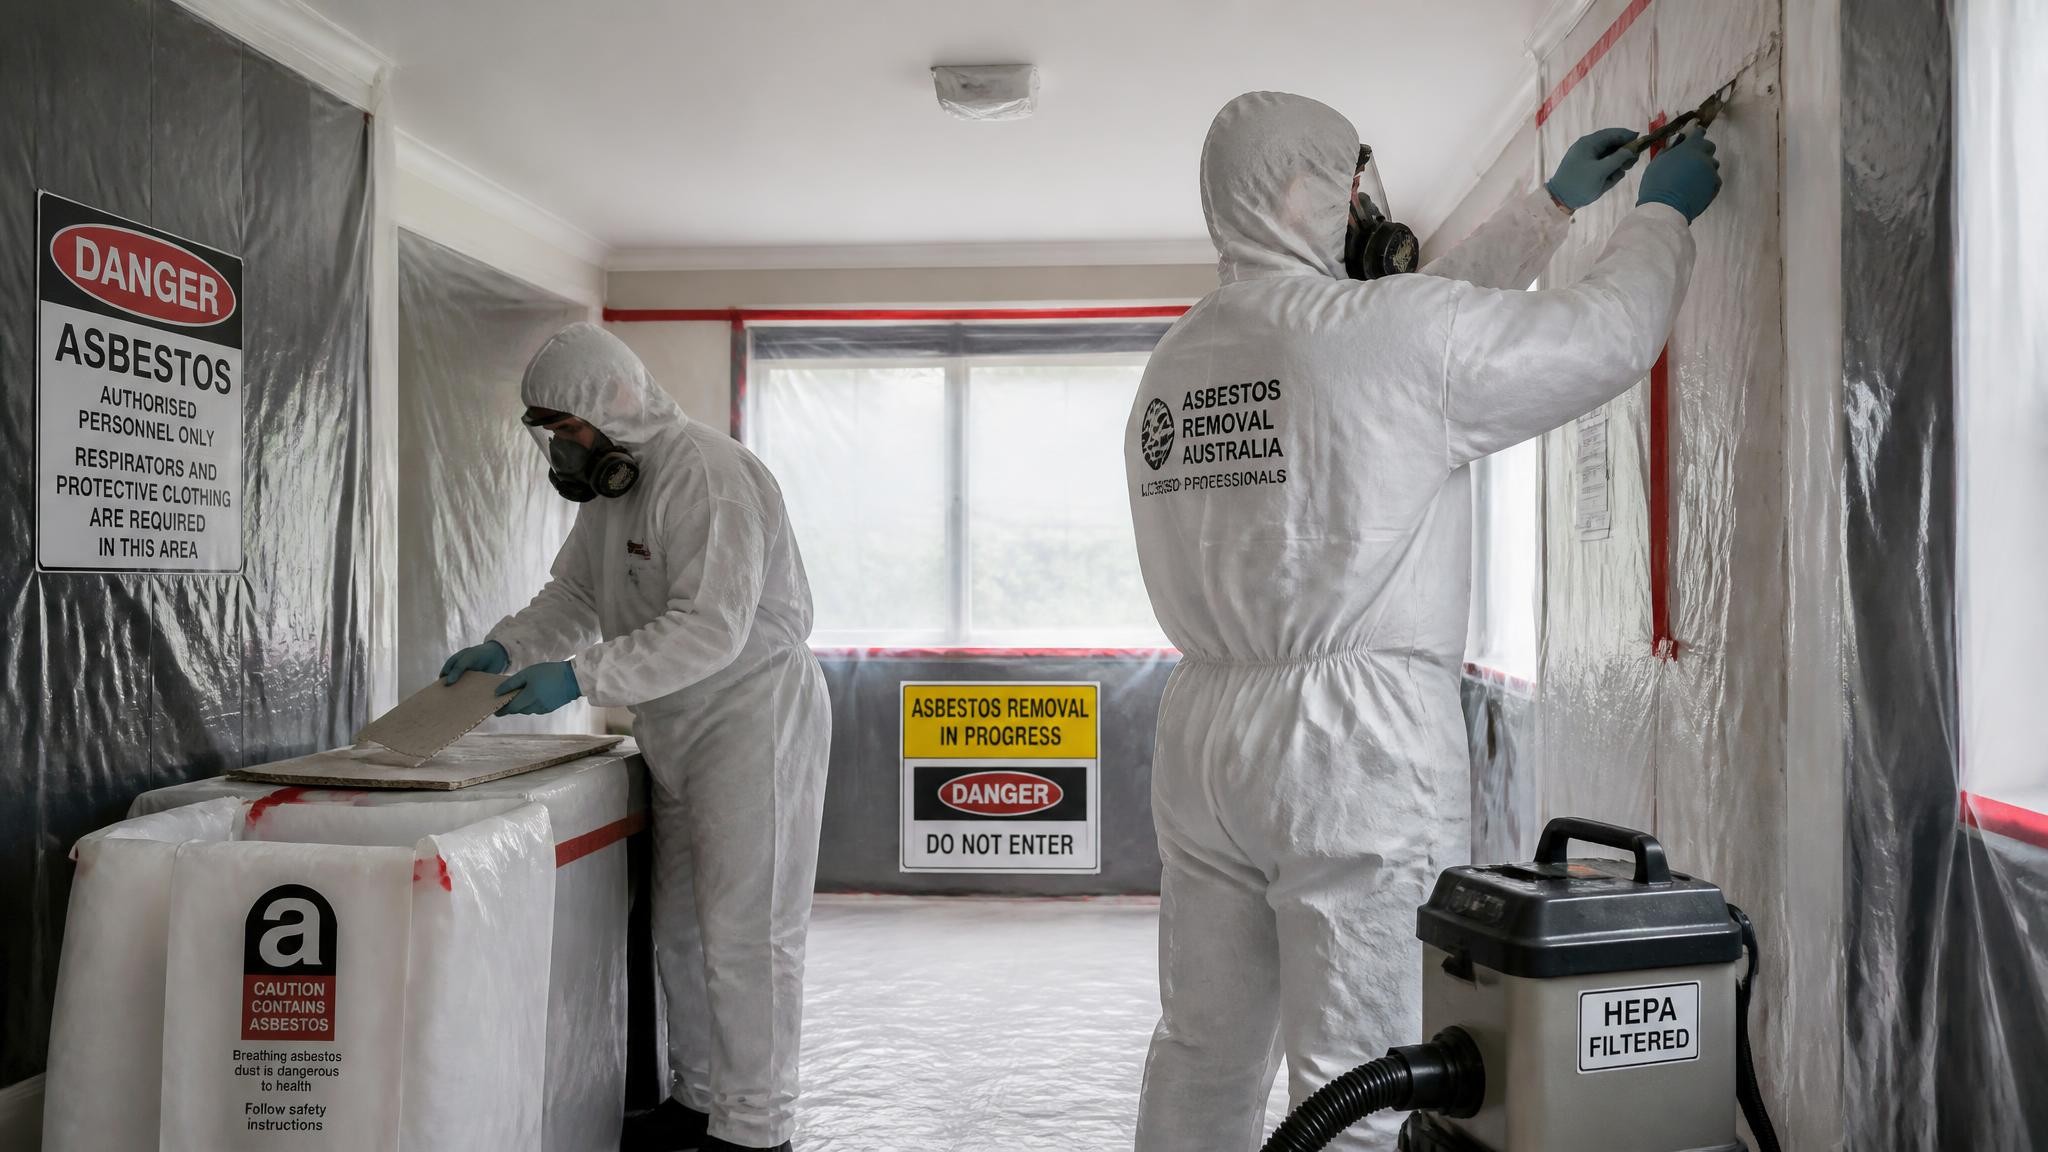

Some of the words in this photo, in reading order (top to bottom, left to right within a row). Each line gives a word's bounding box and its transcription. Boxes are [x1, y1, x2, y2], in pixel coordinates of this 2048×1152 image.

[75, 236, 219, 316] DANGER
[55, 323, 231, 394] ASBESTOS
[100, 386, 197, 419] AUTHORISED
[1182, 379, 1281, 411] ASBESTOS
[79, 410, 174, 443] PERSONNEL
[178, 426, 215, 447] ONLY
[1182, 409, 1274, 438] REMOVAL
[1182, 437, 1284, 465] AUSTRALIA
[75, 447, 185, 477] RESPIRATORS
[188, 461, 217, 481] AND
[56, 475, 158, 502] PROTECTIVE
[162, 485, 231, 508] CLOTHING
[89, 507, 124, 528] ARE
[130, 509, 206, 533] REQUIRED
[99, 537, 115, 556] IN
[120, 538, 155, 558] THIS
[159, 540, 198, 559] AREA
[911, 698, 1001, 718] ASBESTOS
[1007, 698, 1089, 718] REMOVAL
[940, 726, 957, 745] IN
[965, 726, 1061, 746] PROGRESS
[952, 783, 1049, 805] DANGER
[927, 833, 954, 854] DO
[962, 833, 1002, 855] NOT
[1009, 834, 1073, 855] ENTER
[259, 897, 323, 968] a
[254, 981, 325, 997] CAUTION
[252, 1000, 325, 1014] CONTAINS
[1604, 997, 1677, 1026] HEPA
[249, 1017, 329, 1032] ASBESTOS
[1589, 1028, 1690, 1058] FILTERED
[233, 1050, 287, 1063] Breathing
[290, 1050, 342, 1062] asbestos
[234, 1065, 261, 1077] dust
[263, 1065, 273, 1077] is
[277, 1065, 339, 1079] dangerous
[261, 1080, 273, 1092] to
[276, 1079, 311, 1092] health
[245, 1102, 286, 1115] Follow
[289, 1104, 326, 1118] safety
[247, 1117, 323, 1131] instructions
